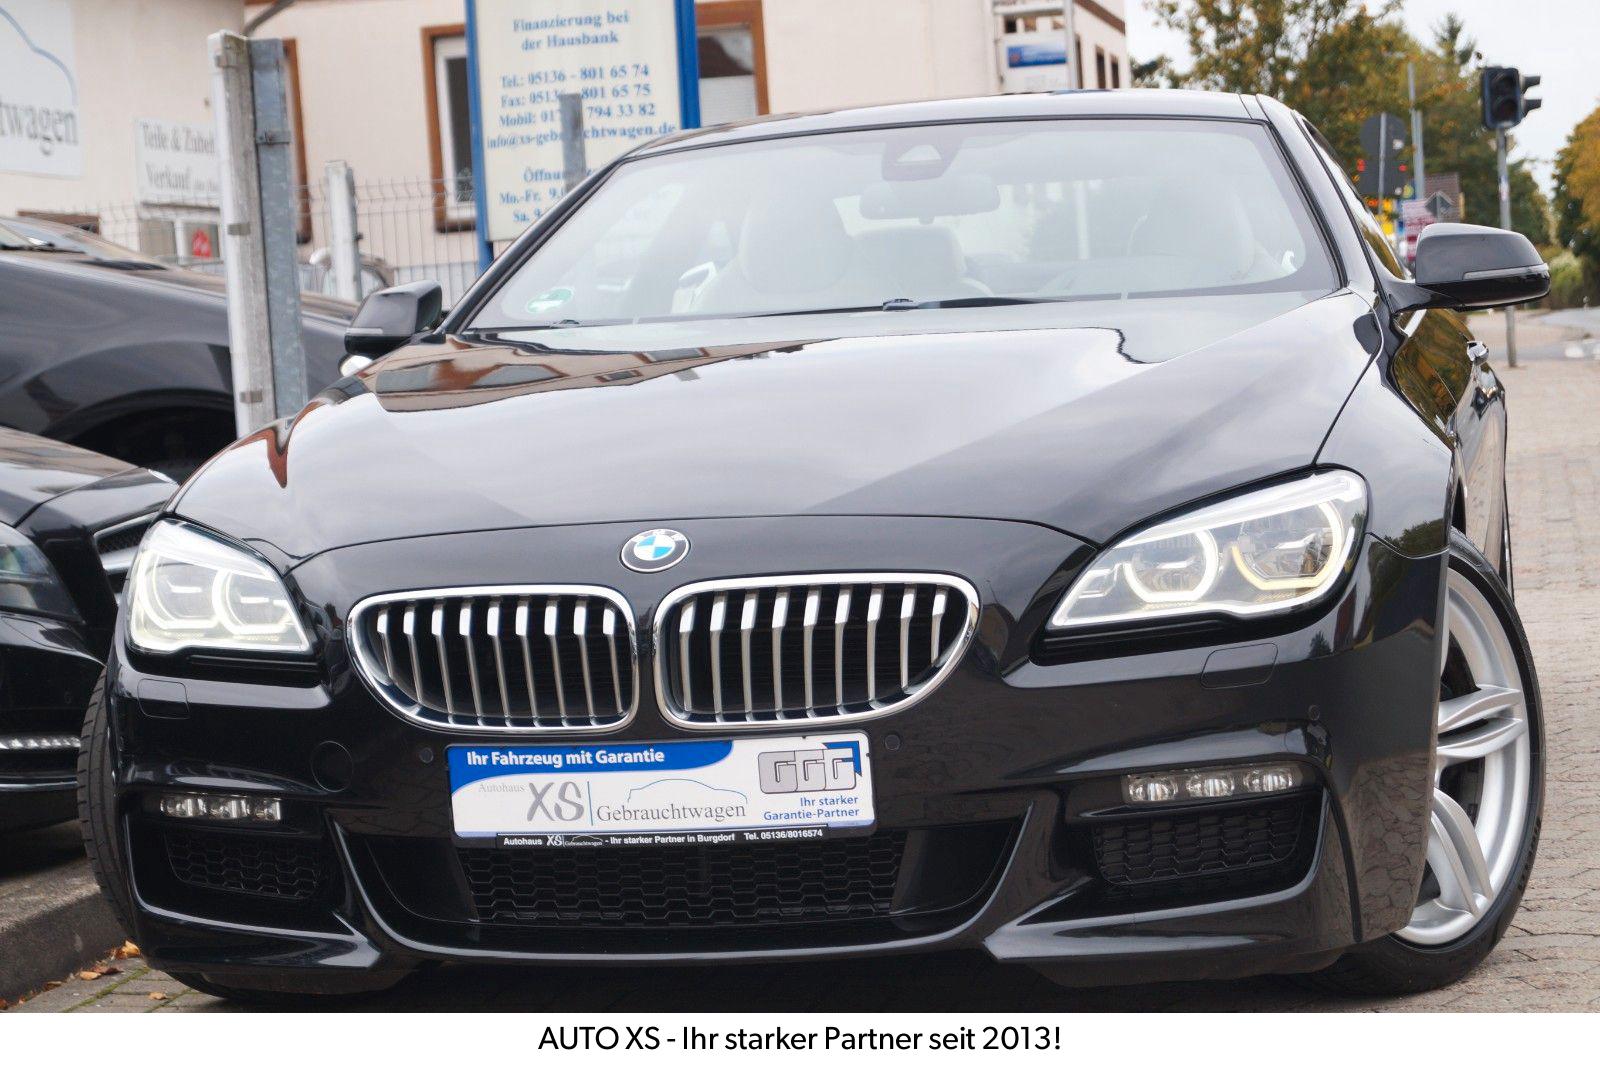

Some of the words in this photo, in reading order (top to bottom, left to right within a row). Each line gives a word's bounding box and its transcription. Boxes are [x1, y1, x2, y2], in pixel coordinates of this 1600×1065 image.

[512, 14, 602, 32] Finanzierung
[606, 10, 629, 24] bei
[521, 37, 541, 51] der
[547, 31, 619, 48] Hausbank
[501, 74, 524, 88] Tel.:
[528, 70, 566, 85] 05136
[580, 66, 604, 80] 801
[610, 64, 628, 79] 65
[632, 63, 650, 78] 74
[501, 94, 525, 108] Fax:
[581, 86, 605, 99] 801
[611, 84, 629, 98] 65
[633, 83, 651, 96] 75
[499, 111, 536, 127] Mobil:
[587, 105, 612, 118] 794
[617, 103, 633, 117] 33
[639, 102, 656, 116] 82
[170, 125, 181, 151] &
[466, 751, 489, 766] Ihr
[491, 750, 563, 769] Fahrzeug
[565, 750, 594, 765] mit
[595, 748, 665, 764] Garantie
[478, 783, 526, 793] Autohaus
[526, 781, 585, 822] XS
[800, 796, 816, 807] Ihr
[819, 795, 859, 806] starker
[597, 803, 747, 823] Gebrauchtwagen
[763, 808, 860, 821] Garantie-Partner
[503, 837, 543, 846] Autohaus
[546, 835, 563, 847] XS
[610, 836, 622, 845] Ihr
[623, 835, 653, 845] starker
[654, 834, 686, 844] Partner
[687, 834, 696, 843] in
[697, 833, 736, 844] Burgdorf
[743, 831, 760, 841] Tel.
[760, 829, 824, 841] 05136/8016574
